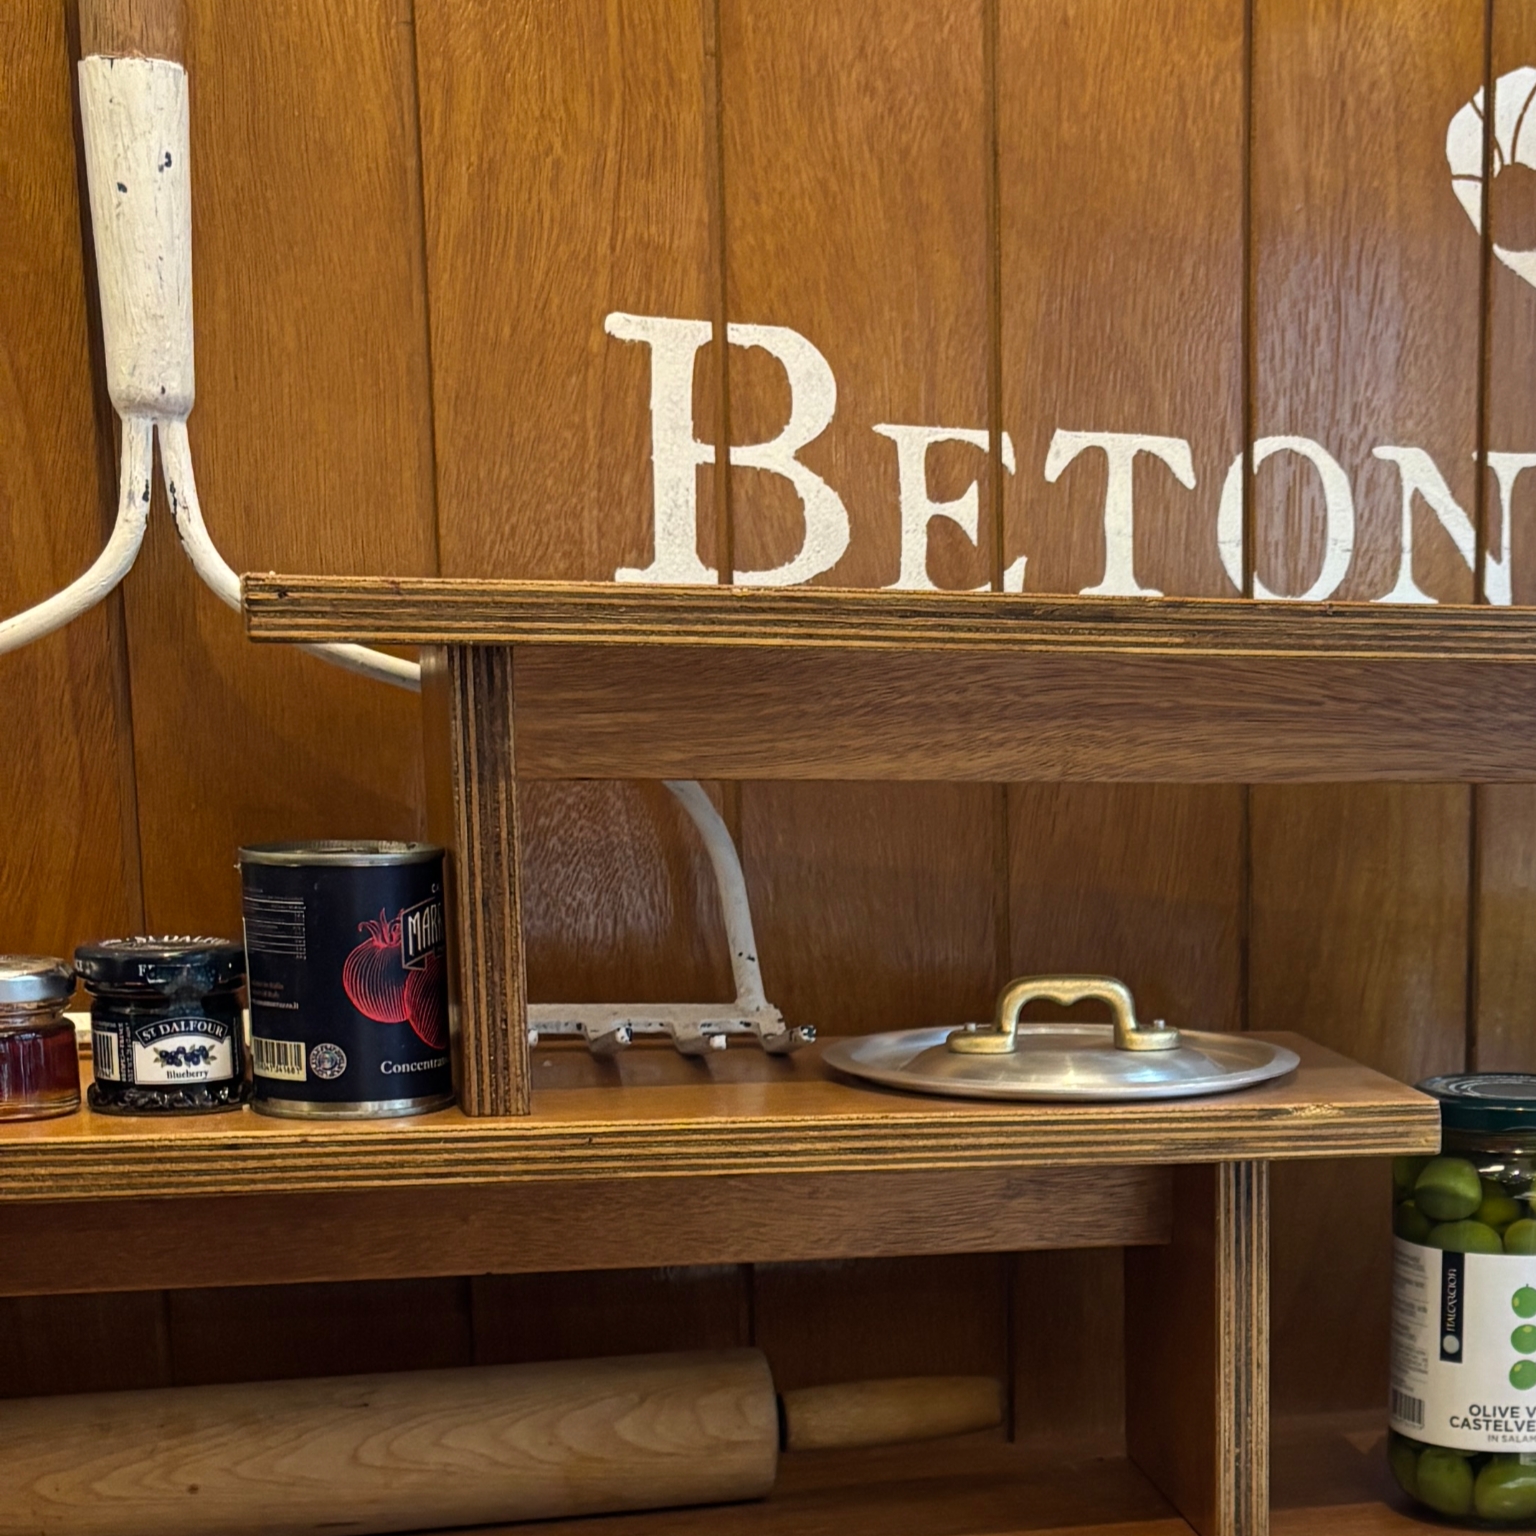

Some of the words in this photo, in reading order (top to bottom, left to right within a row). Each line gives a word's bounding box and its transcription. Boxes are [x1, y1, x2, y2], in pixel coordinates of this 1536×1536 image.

[159, 1020, 224, 1037] DALFOUR
[166, 1069, 209, 1080] Blueberry
[1469, 1404, 1520, 1418] OLIVE
[1487, 1435, 1499, 1443] IN
